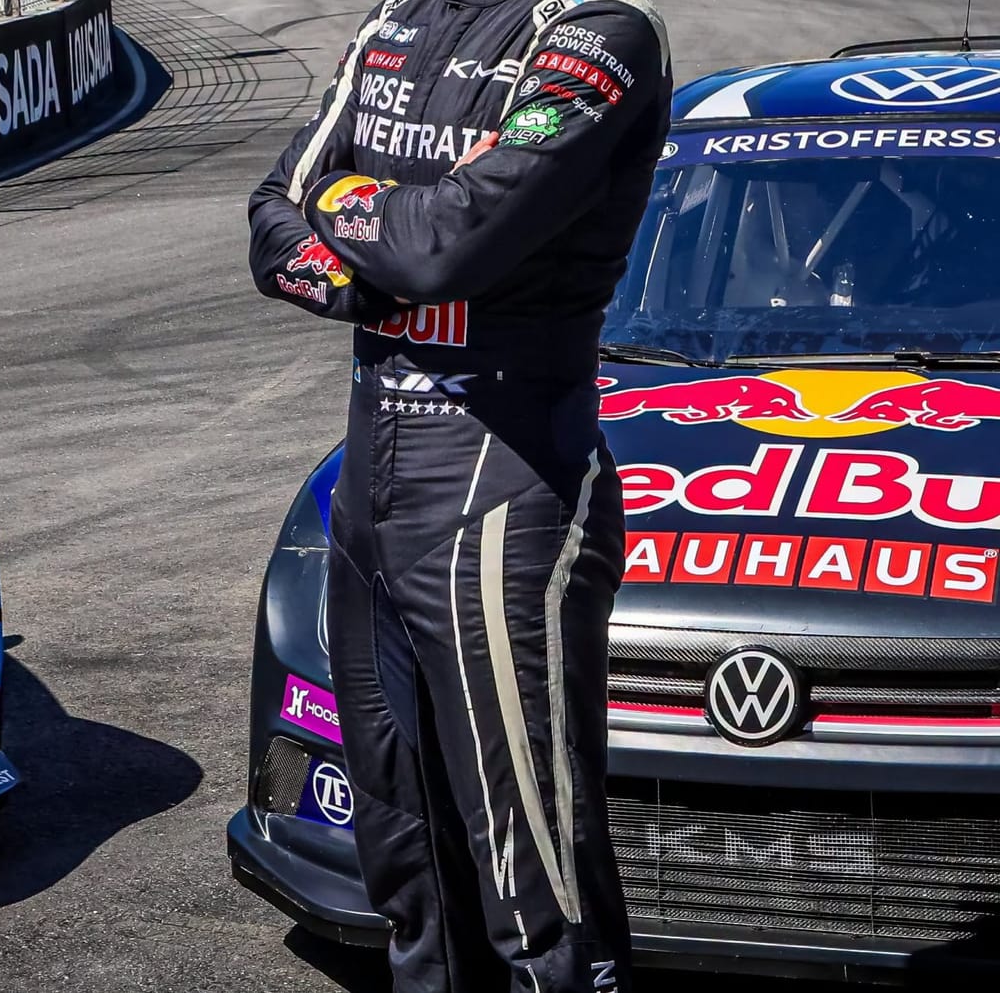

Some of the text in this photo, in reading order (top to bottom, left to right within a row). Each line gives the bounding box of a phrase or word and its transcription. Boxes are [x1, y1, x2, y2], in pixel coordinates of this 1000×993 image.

[67, 9, 114, 105] LOUSADA
[546, 34, 635, 88] POWERTRAIN
[553, 24, 607, 48] HORSE
[443, 57, 522, 84] KMS
[536, 54, 621, 102] BAUHAUS
[625, 539, 989, 592] AUHAUS
